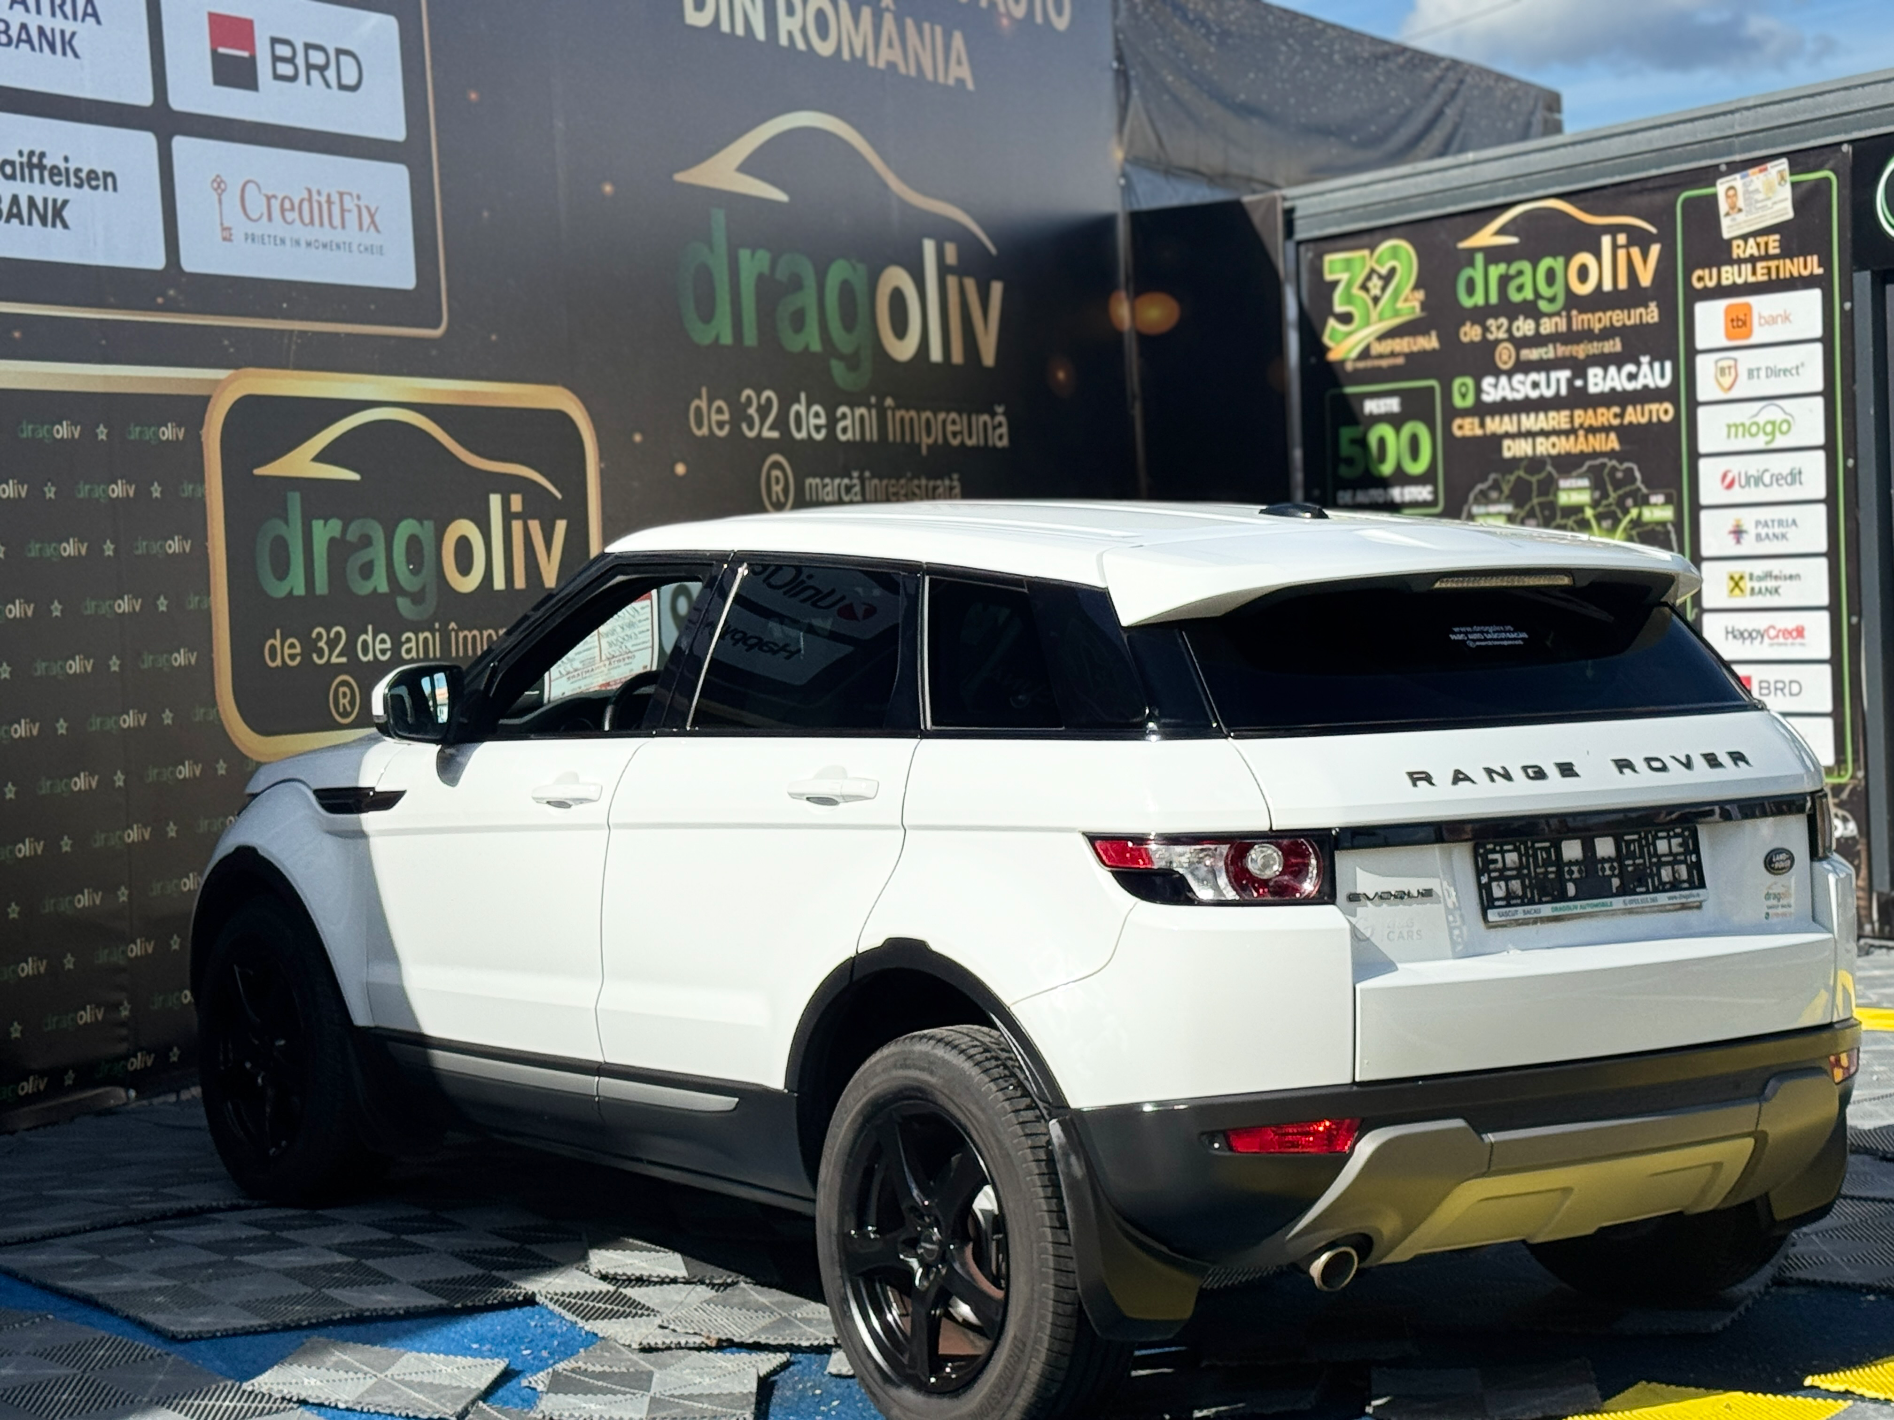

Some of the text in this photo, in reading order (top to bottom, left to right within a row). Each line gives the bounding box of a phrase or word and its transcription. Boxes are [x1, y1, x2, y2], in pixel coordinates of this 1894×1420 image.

[269, 36, 364, 93] BRD
[0, 148, 118, 193] aiffeisen
[0, 192, 71, 231] ANK
[239, 178, 382, 234] CreditFix
[244, 231, 287, 248] PRIETEN
[305, 238, 353, 255] MOMENTE
[356, 242, 385, 256] CHEIE
[1731, 233, 1781, 260] RATE
[1456, 233, 1662, 314] dragoliv
[1691, 254, 1824, 290] CU BULETINUL
[677, 207, 1004, 392] dragoliv
[1459, 301, 1660, 343] de 32 de ani împreună
[1730, 310, 1792, 330] tbi bank
[1480, 368, 1572, 403] SASCUT
[1586, 355, 1673, 395] BACĂU
[1719, 365, 1733, 378] BT
[1747, 366, 1762, 381] BT
[18, 420, 186, 445] dragoliv dragoliv
[688, 386, 1010, 457] de 32 de ani împreună
[1452, 401, 1675, 439] CEL MAI MARE PARC AUTO
[1725, 418, 1793, 446] mogo
[1337, 419, 1433, 480] 500
[1502, 429, 1621, 460] DIN ROMÂNIA
[0, 478, 136, 503] oliv dragoliv
[804, 470, 862, 502] marcă
[1738, 467, 1804, 489] UniCredit
[1754, 517, 1799, 530] PATRIA
[1755, 531, 1789, 543] BANK
[26, 535, 192, 561] dragoliv dragoliv
[254, 491, 568, 622] dragoliv
[1749, 569, 1802, 583] Raiffeisen
[83, 593, 142, 618] dragoliv
[1749, 586, 1782, 598] BANK
[263, 621, 508, 668] de 32 de ani împr
[1724, 624, 1806, 646] HappyCredit
[33, 648, 198, 680] dragoliv dragoliv
[1758, 679, 1803, 697] BRD
[1405, 750, 1753, 788] RANGE ROVER
[1346, 888, 1434, 903] EVOQUE
